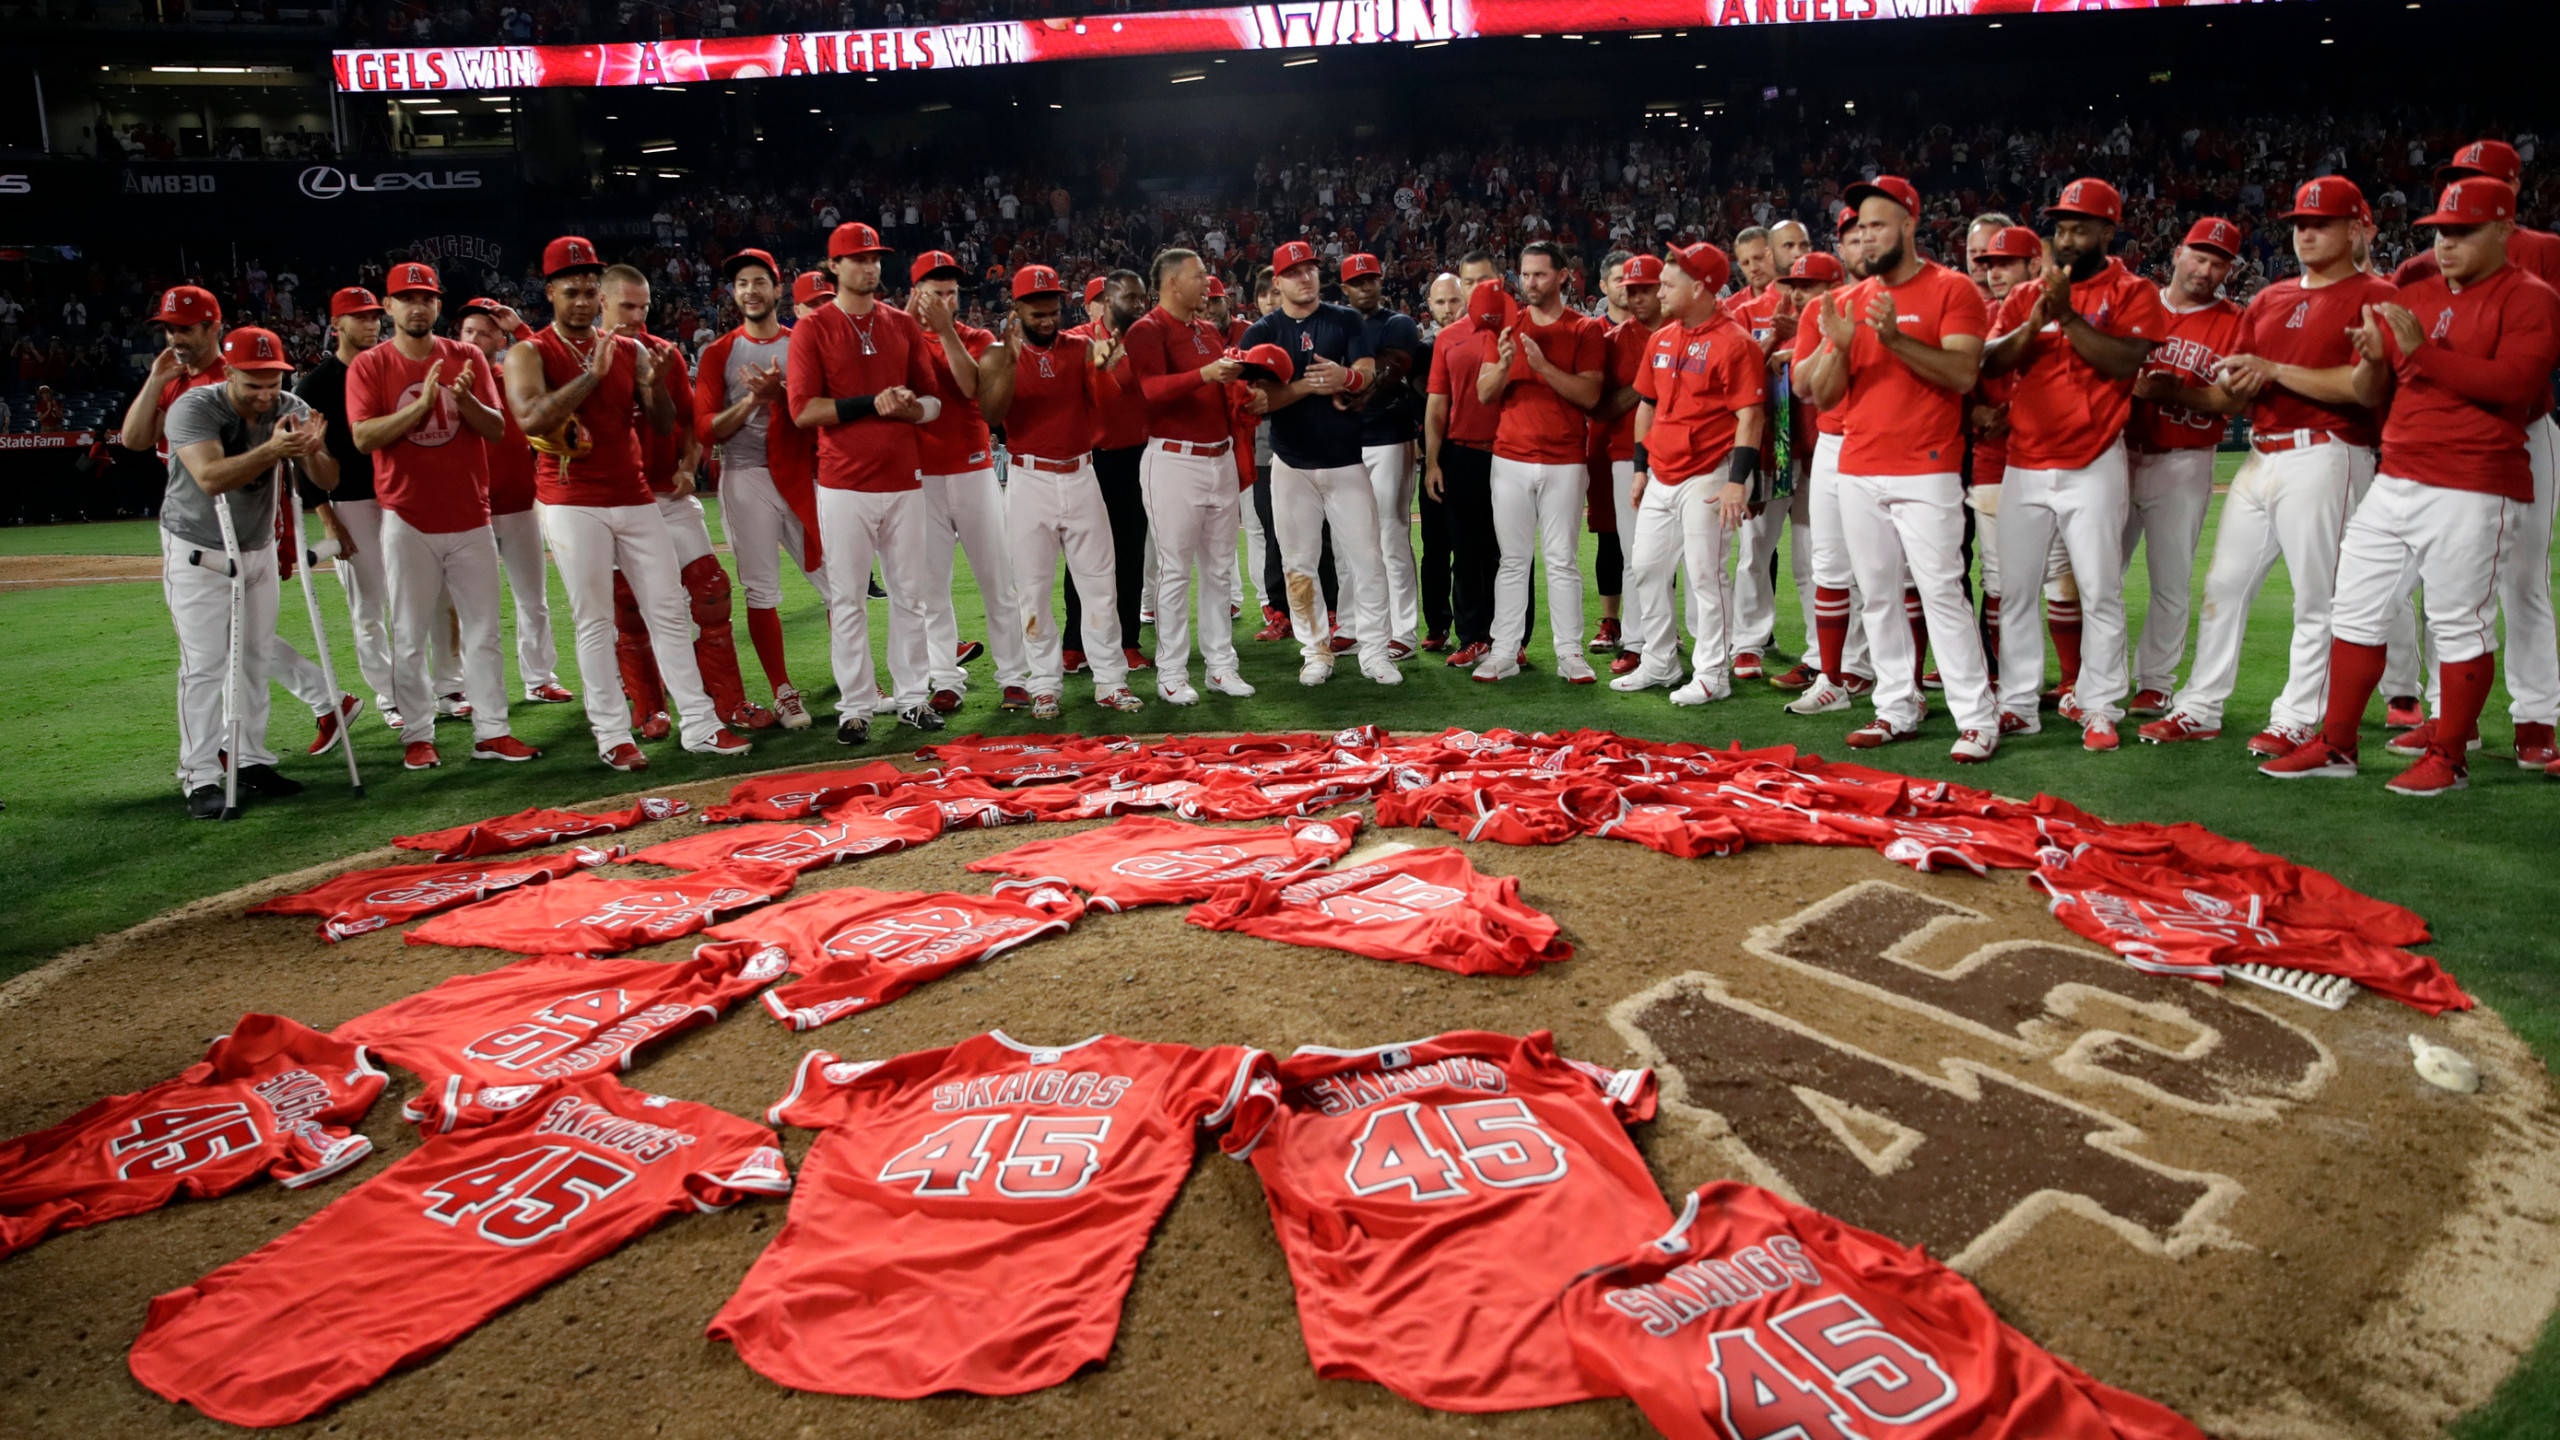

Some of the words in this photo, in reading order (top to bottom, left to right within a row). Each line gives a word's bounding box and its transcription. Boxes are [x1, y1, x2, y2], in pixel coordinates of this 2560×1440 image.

[780, 30, 935, 76] ANGELS
[942, 23, 1025, 68] WIN
[1250, 0, 1458, 47] WIN
[454, 47, 536, 88] WIN
[350, 169, 482, 191] LEXUS
[823, 906, 973, 958] 45
[462, 987, 632, 1071] 45
[530, 1003, 693, 1080] SKAGGS
[934, 1069, 1133, 1112] SKAGGS
[1300, 1056, 1507, 1117] SKAGGS
[1606, 880, 2338, 1272] 45
[110, 1101, 262, 1181] 45
[534, 1096, 696, 1164] SKAGGS
[877, 1113, 1113, 1198] 45
[1345, 1098, 1568, 1202] 45
[422, 1144, 637, 1247] 45
[1604, 1234, 1822, 1337] SKAGGS
[1705, 1293, 1959, 1440] 45
